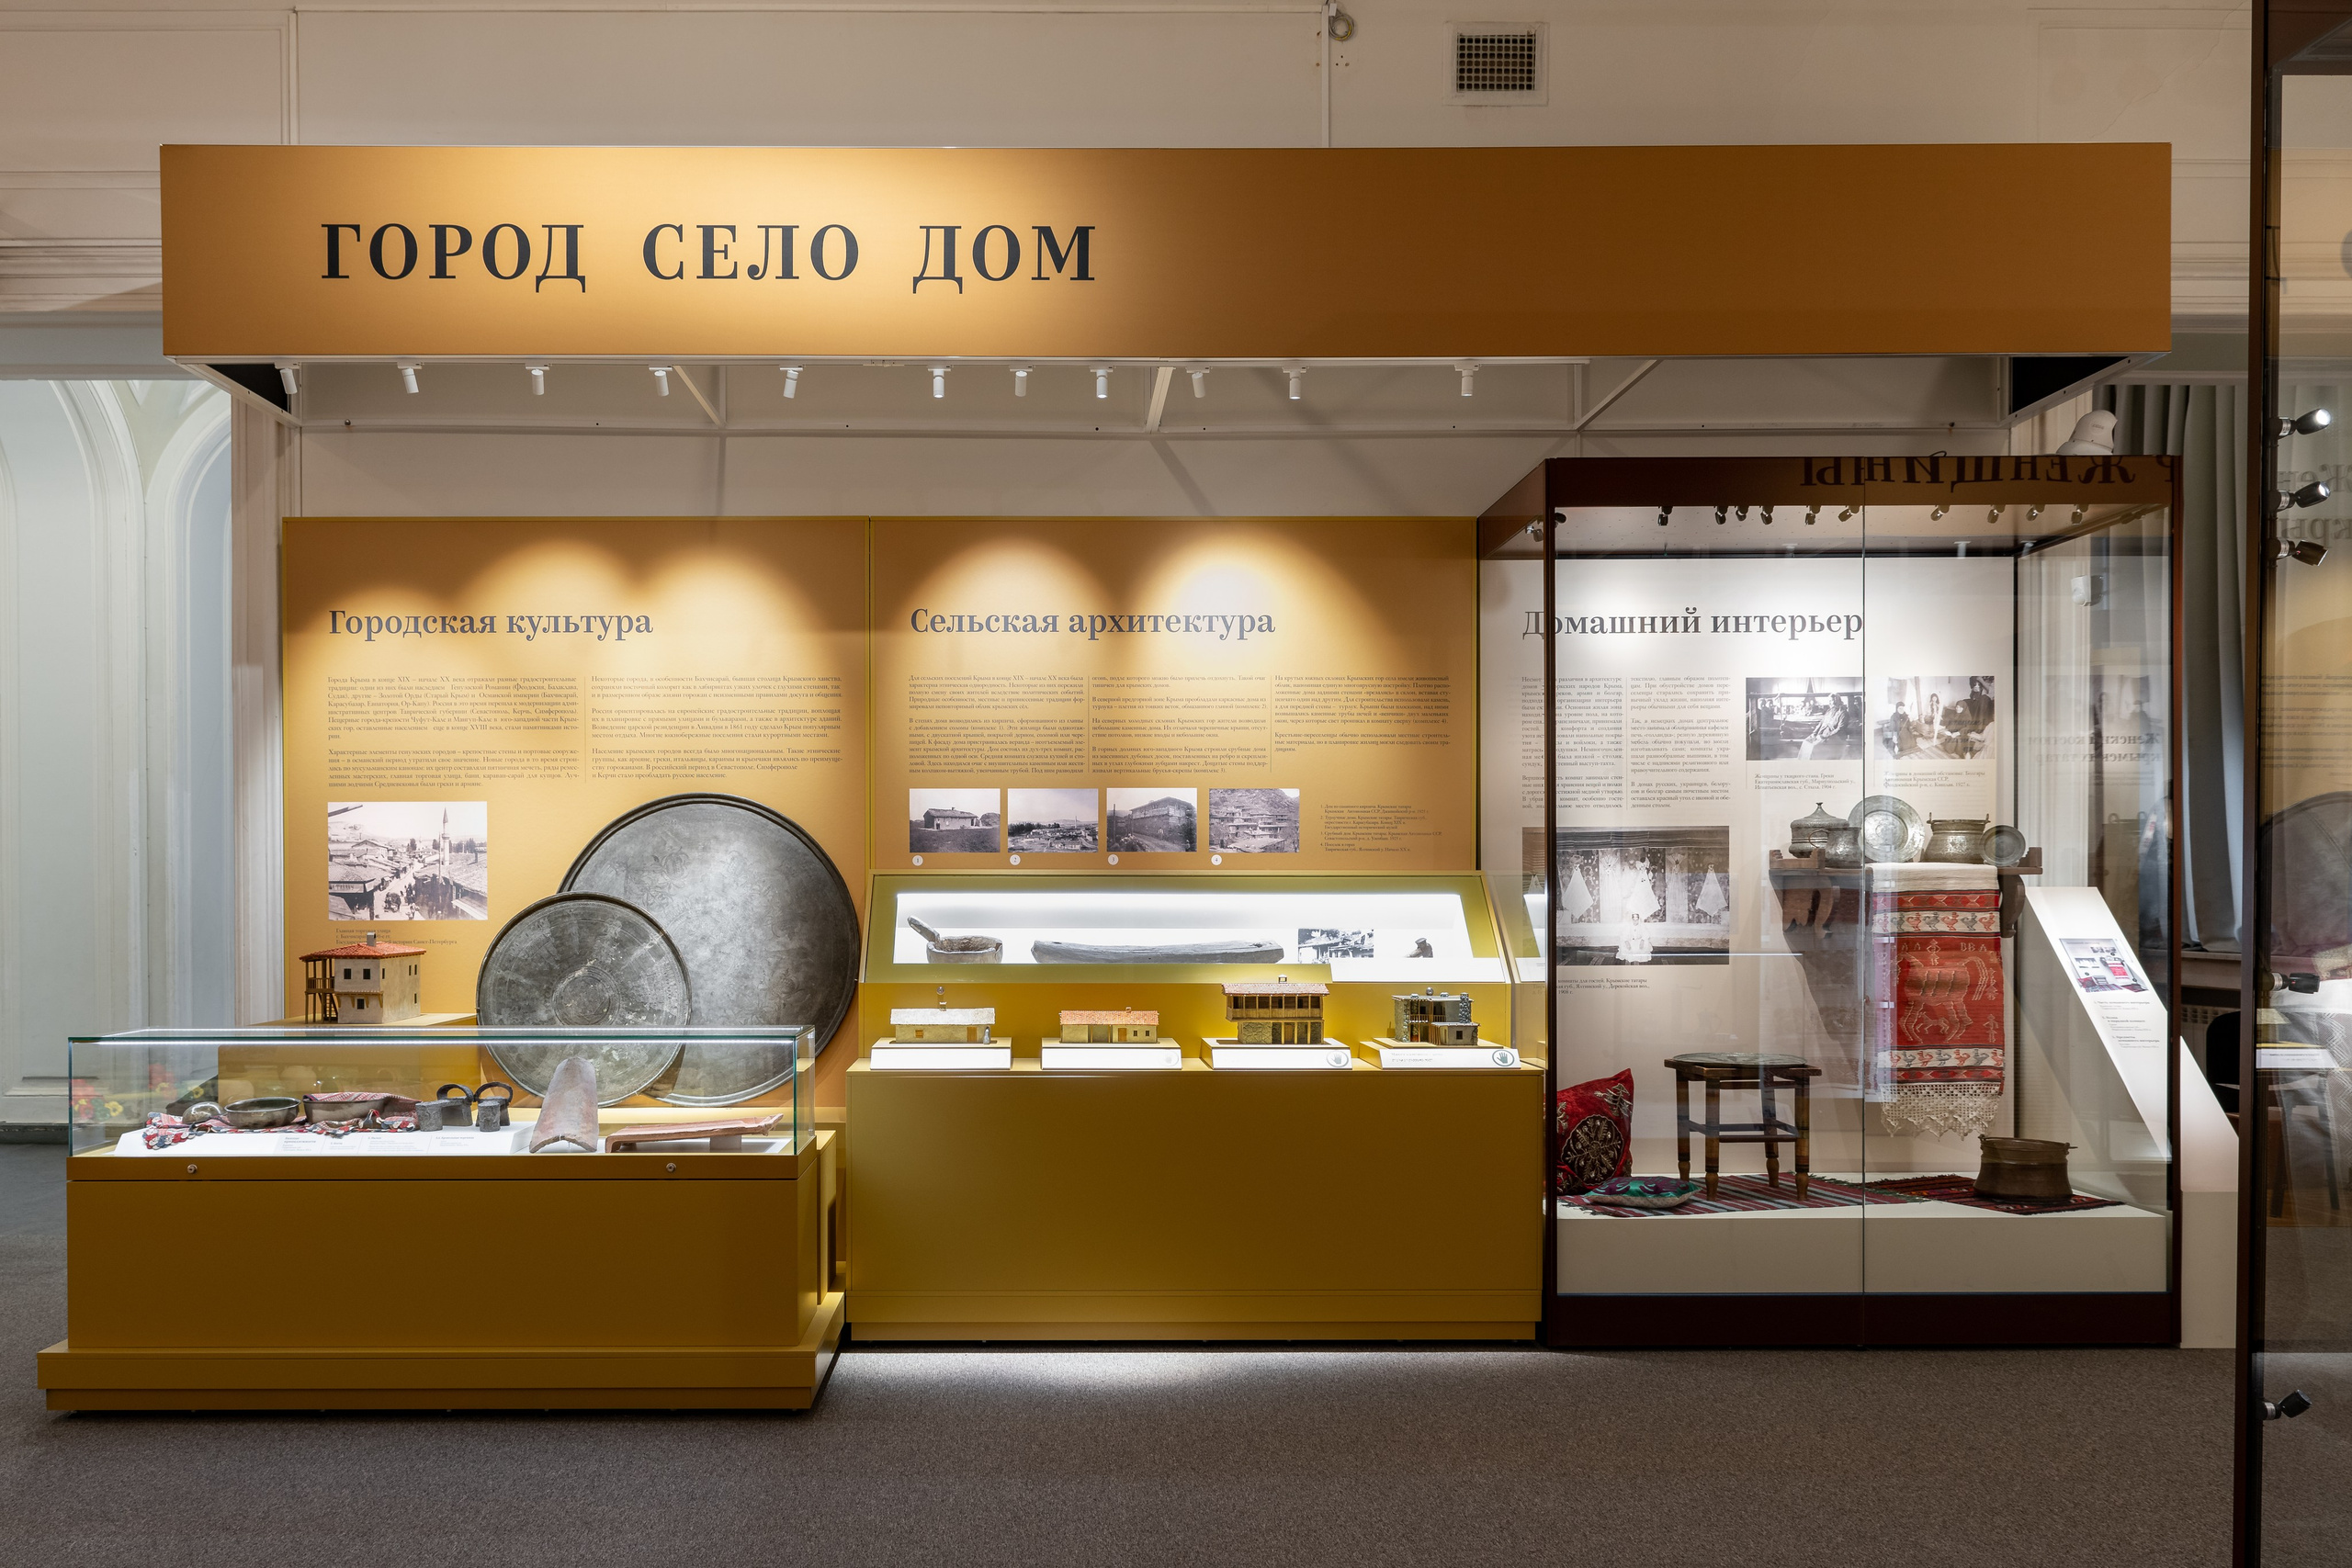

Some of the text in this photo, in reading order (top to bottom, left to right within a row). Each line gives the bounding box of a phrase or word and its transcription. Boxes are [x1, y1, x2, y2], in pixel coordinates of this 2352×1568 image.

[322, 223, 1096, 294] ГОРОД СЕЛО ДОМ
[328, 609, 654, 642] Городская культура
[910, 607, 1276, 641] Сельская архитектура
[1711, 613, 1863, 641] интерьер
